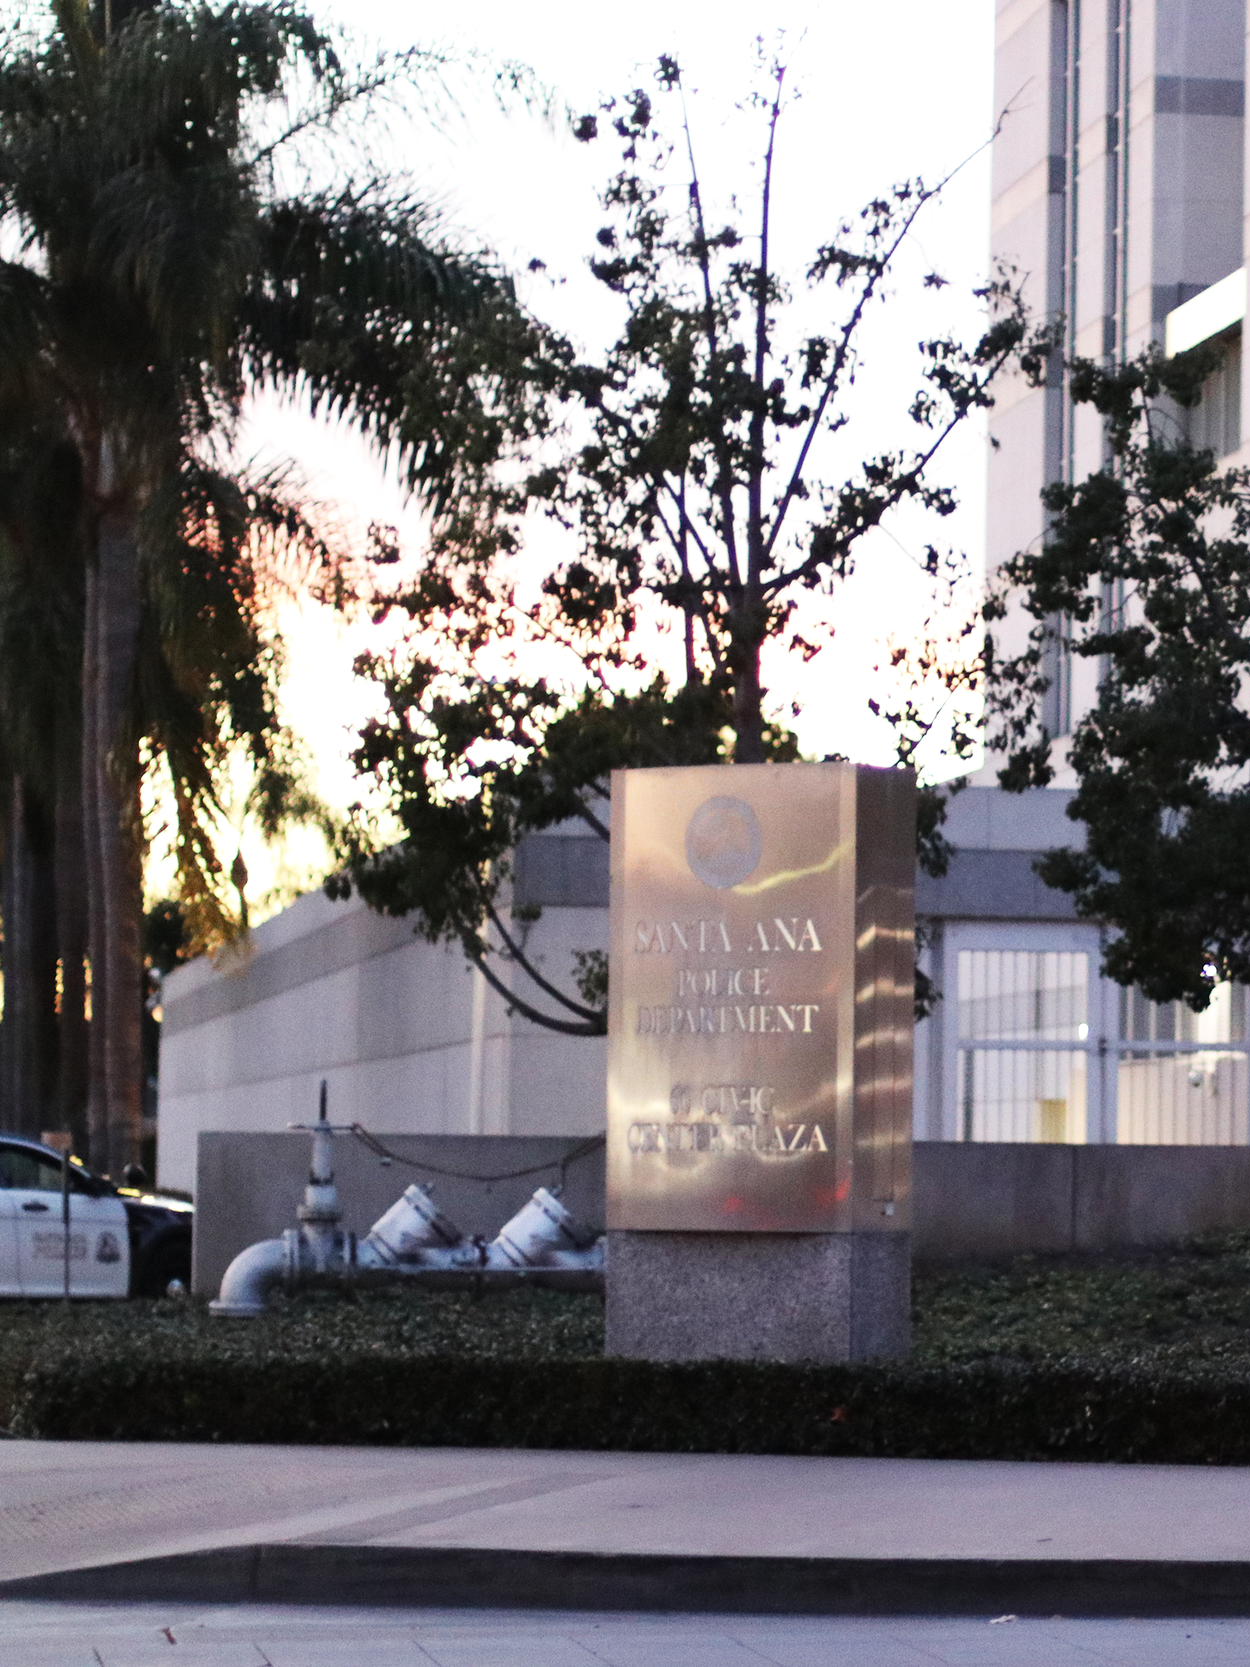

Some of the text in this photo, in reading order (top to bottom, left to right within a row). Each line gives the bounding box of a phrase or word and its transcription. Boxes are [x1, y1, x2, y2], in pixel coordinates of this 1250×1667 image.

[634, 917, 822, 953] SANTA ANA
[678, 968, 770, 996] POLICE
[637, 1005, 819, 1033] DEPARTMENT
[701, 1085, 775, 1115] CIVIC
[733, 1123, 828, 1152] PLAZA
